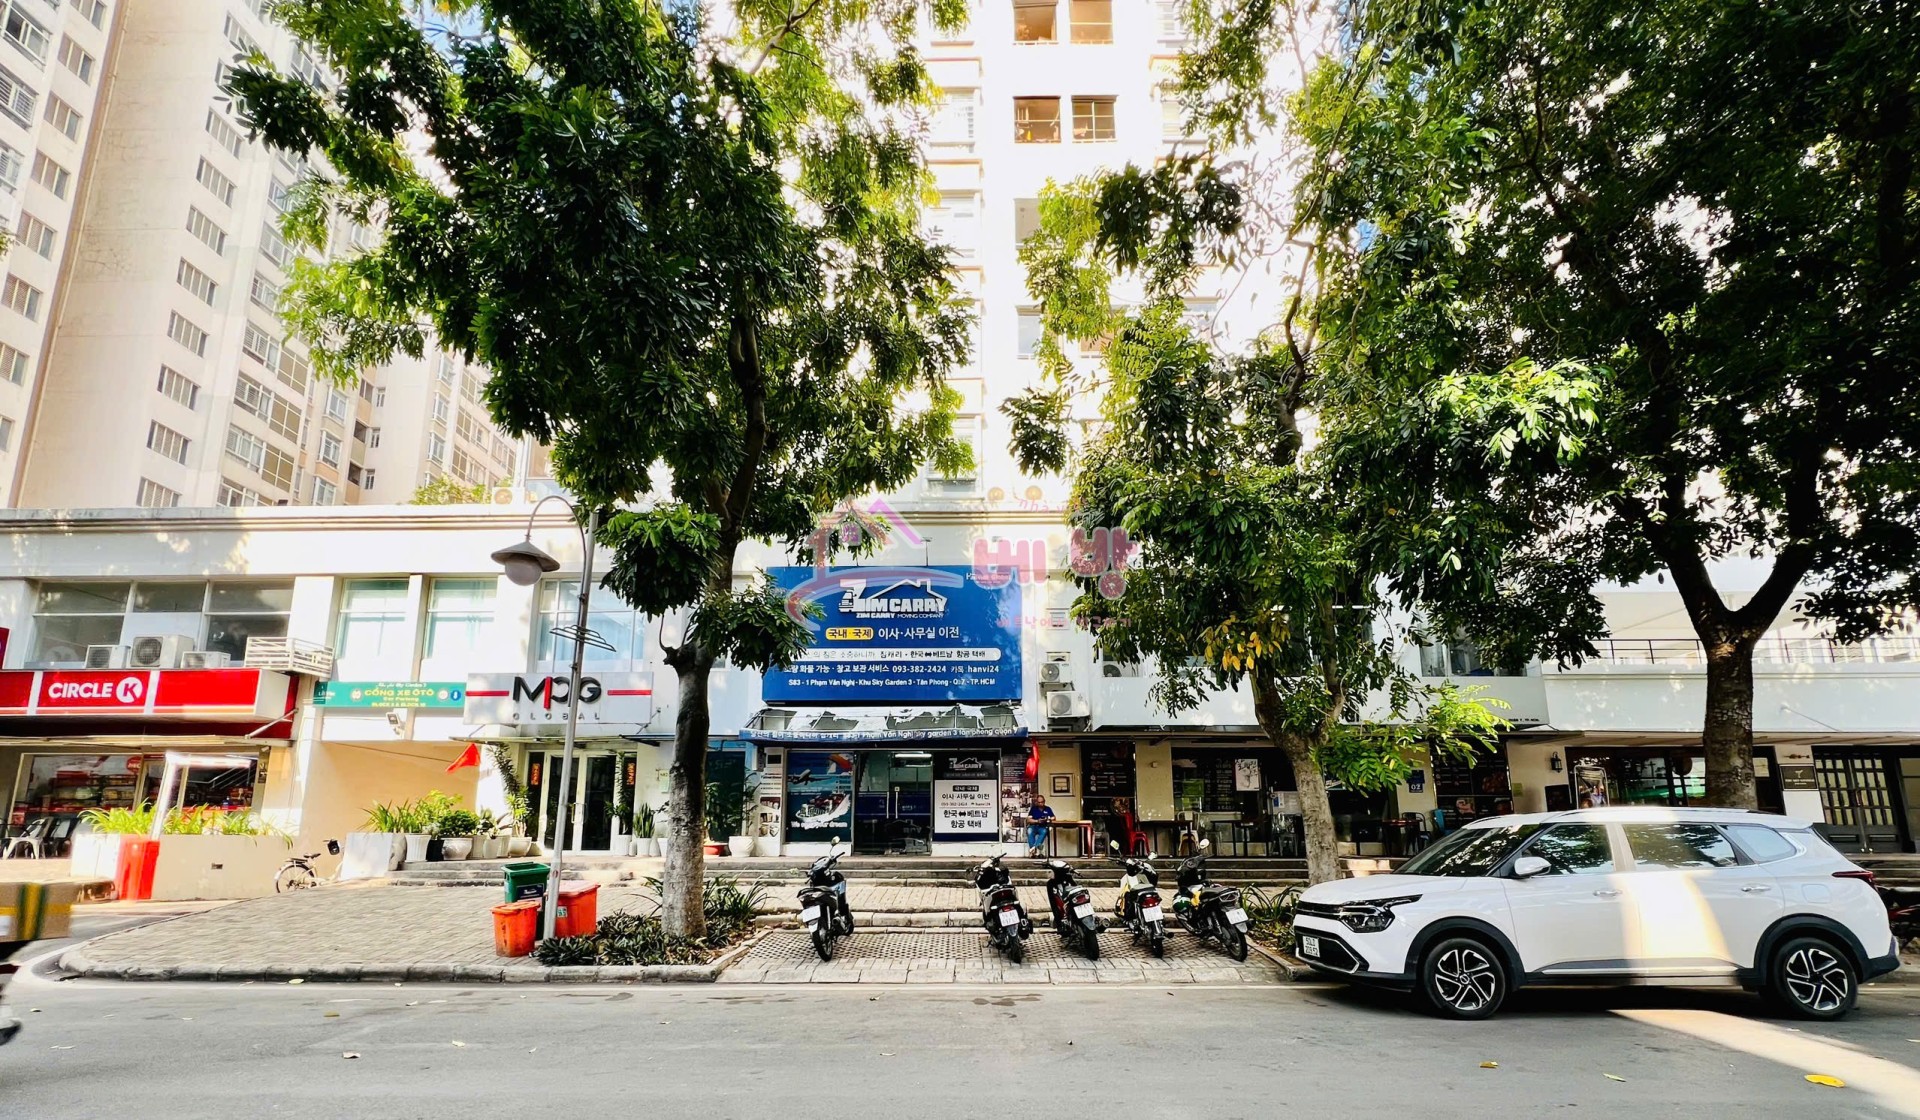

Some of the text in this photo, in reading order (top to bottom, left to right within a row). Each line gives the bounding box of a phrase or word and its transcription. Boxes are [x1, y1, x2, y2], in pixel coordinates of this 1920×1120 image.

[890, 598, 948, 612] CARRY
[938, 626, 960, 638] 이전
[956, 650, 970, 658] 항공
[971, 650, 986, 658] 택배
[800, 664, 814, 673] 화물
[816, 664, 830, 673] 가능
[836, 664, 851, 673] 창고
[852, 664, 867, 673] 보관
[867, 664, 890, 673] 서비스
[892, 665, 947, 673] 093-382-2424
[967, 665, 999, 673] hanvi24
[872, 679, 883, 687] Sky
[929, 679, 948, 687] Phong
[48, 682, 113, 699] CIRCLE
[513, 712, 600, 720] GLOBAL
[950, 819, 982, 829] 항공 택배
